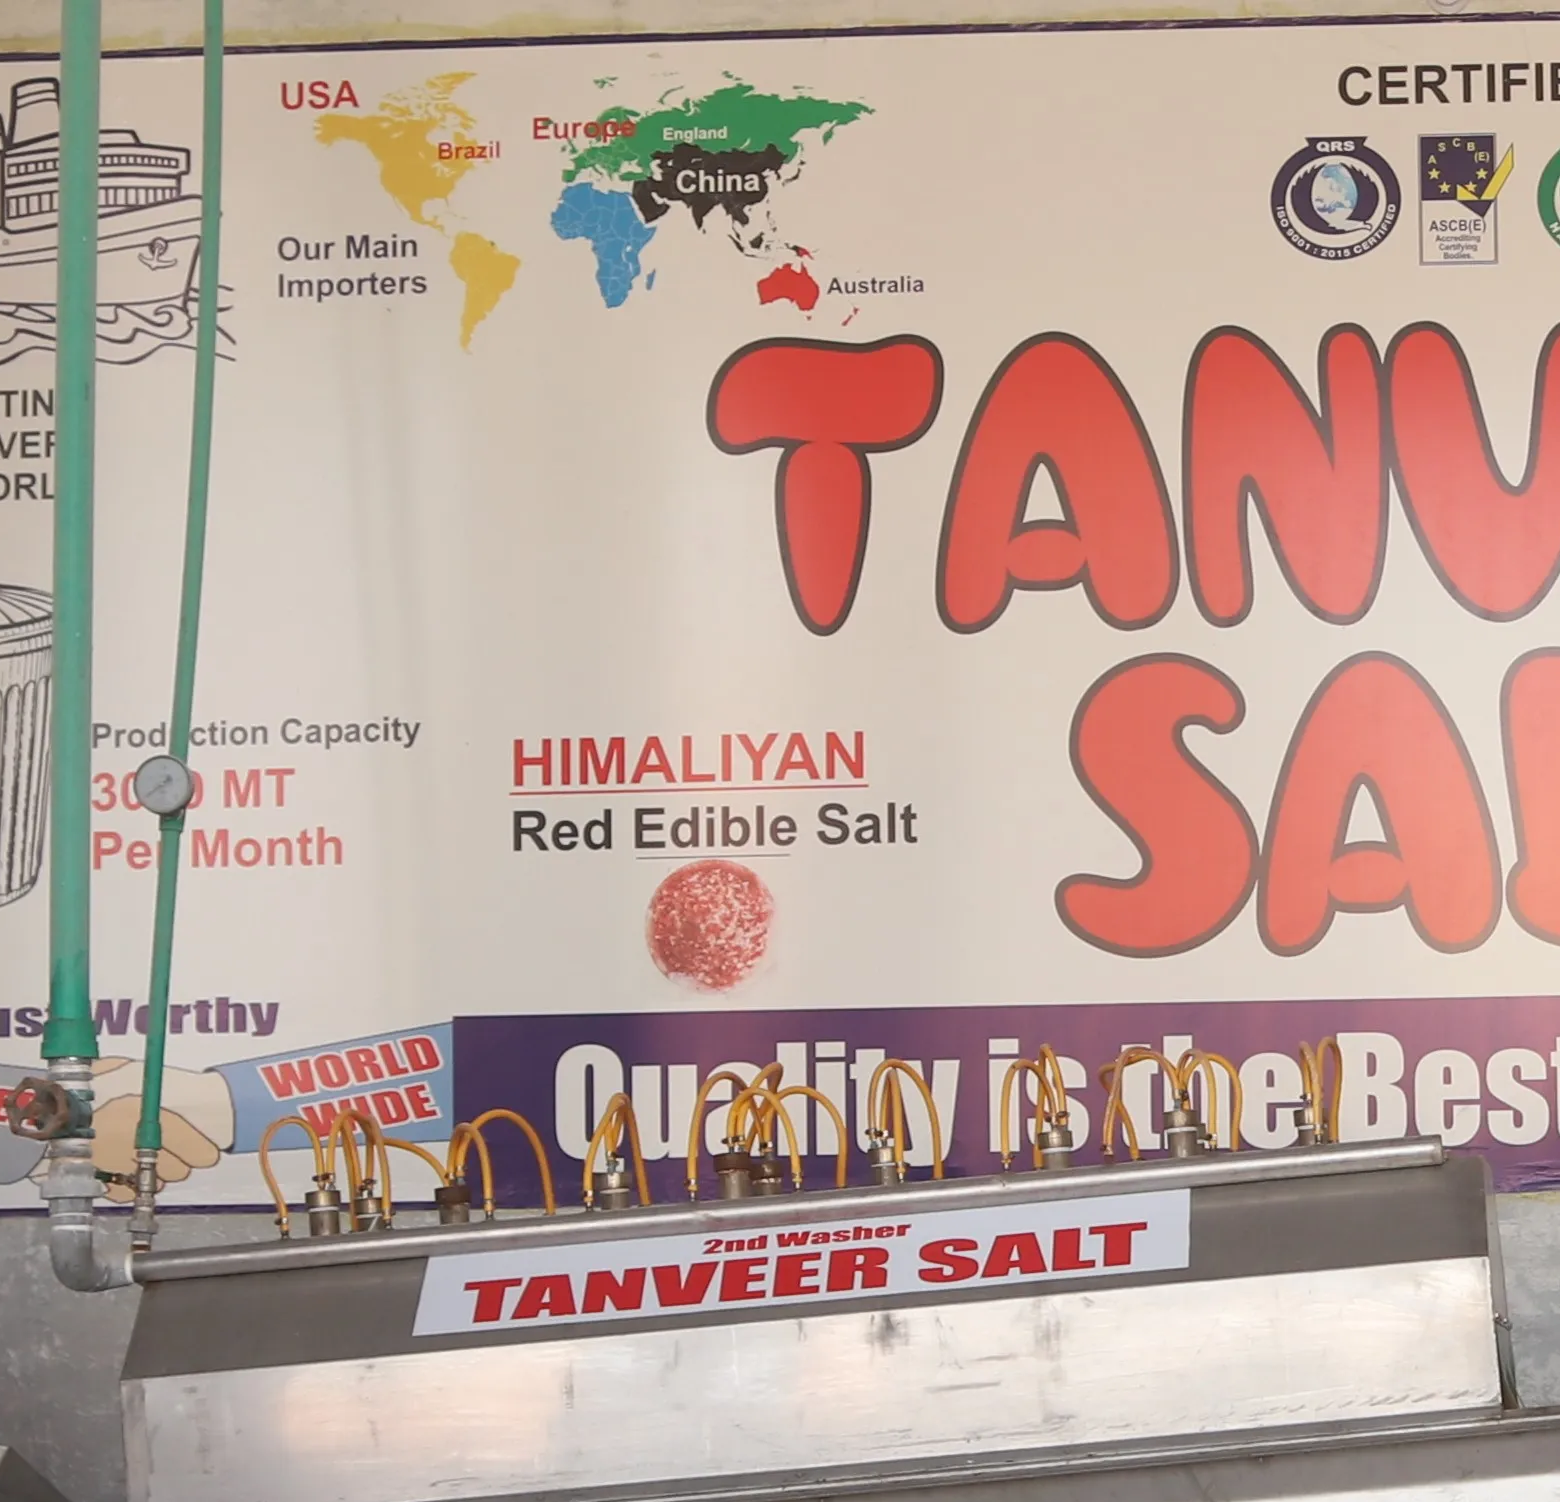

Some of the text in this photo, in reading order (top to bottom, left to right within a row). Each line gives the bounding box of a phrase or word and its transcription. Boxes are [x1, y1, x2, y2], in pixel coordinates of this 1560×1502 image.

[280, 80, 359, 110] USA
[533, 117, 636, 143] Europe
[663, 126, 727, 143] England
[438, 141, 500, 161] Brazil
[1316, 140, 1355, 152] QRS
[676, 169, 761, 194] China
[1429, 219, 1487, 234] ASCB(E)
[278, 234, 418, 261] Our Main
[278, 272, 428, 303] Importers
[827, 275, 924, 295] Australia
[92, 716, 421, 749] Prodction Capacity
[513, 731, 864, 786] HIMALIYAN
[223, 768, 295, 809] MT
[513, 802, 918, 851] Red Edible Salt
[93, 826, 343, 870] Pe Month
[260, 1037, 440, 1098] WORLD
[554, 1040, 960, 1173] Quality
[988, 1037, 1090, 1153] is
[703, 1224, 912, 1255] 2nd Washer
[464, 1221, 1148, 1323] TANVEER SALT
